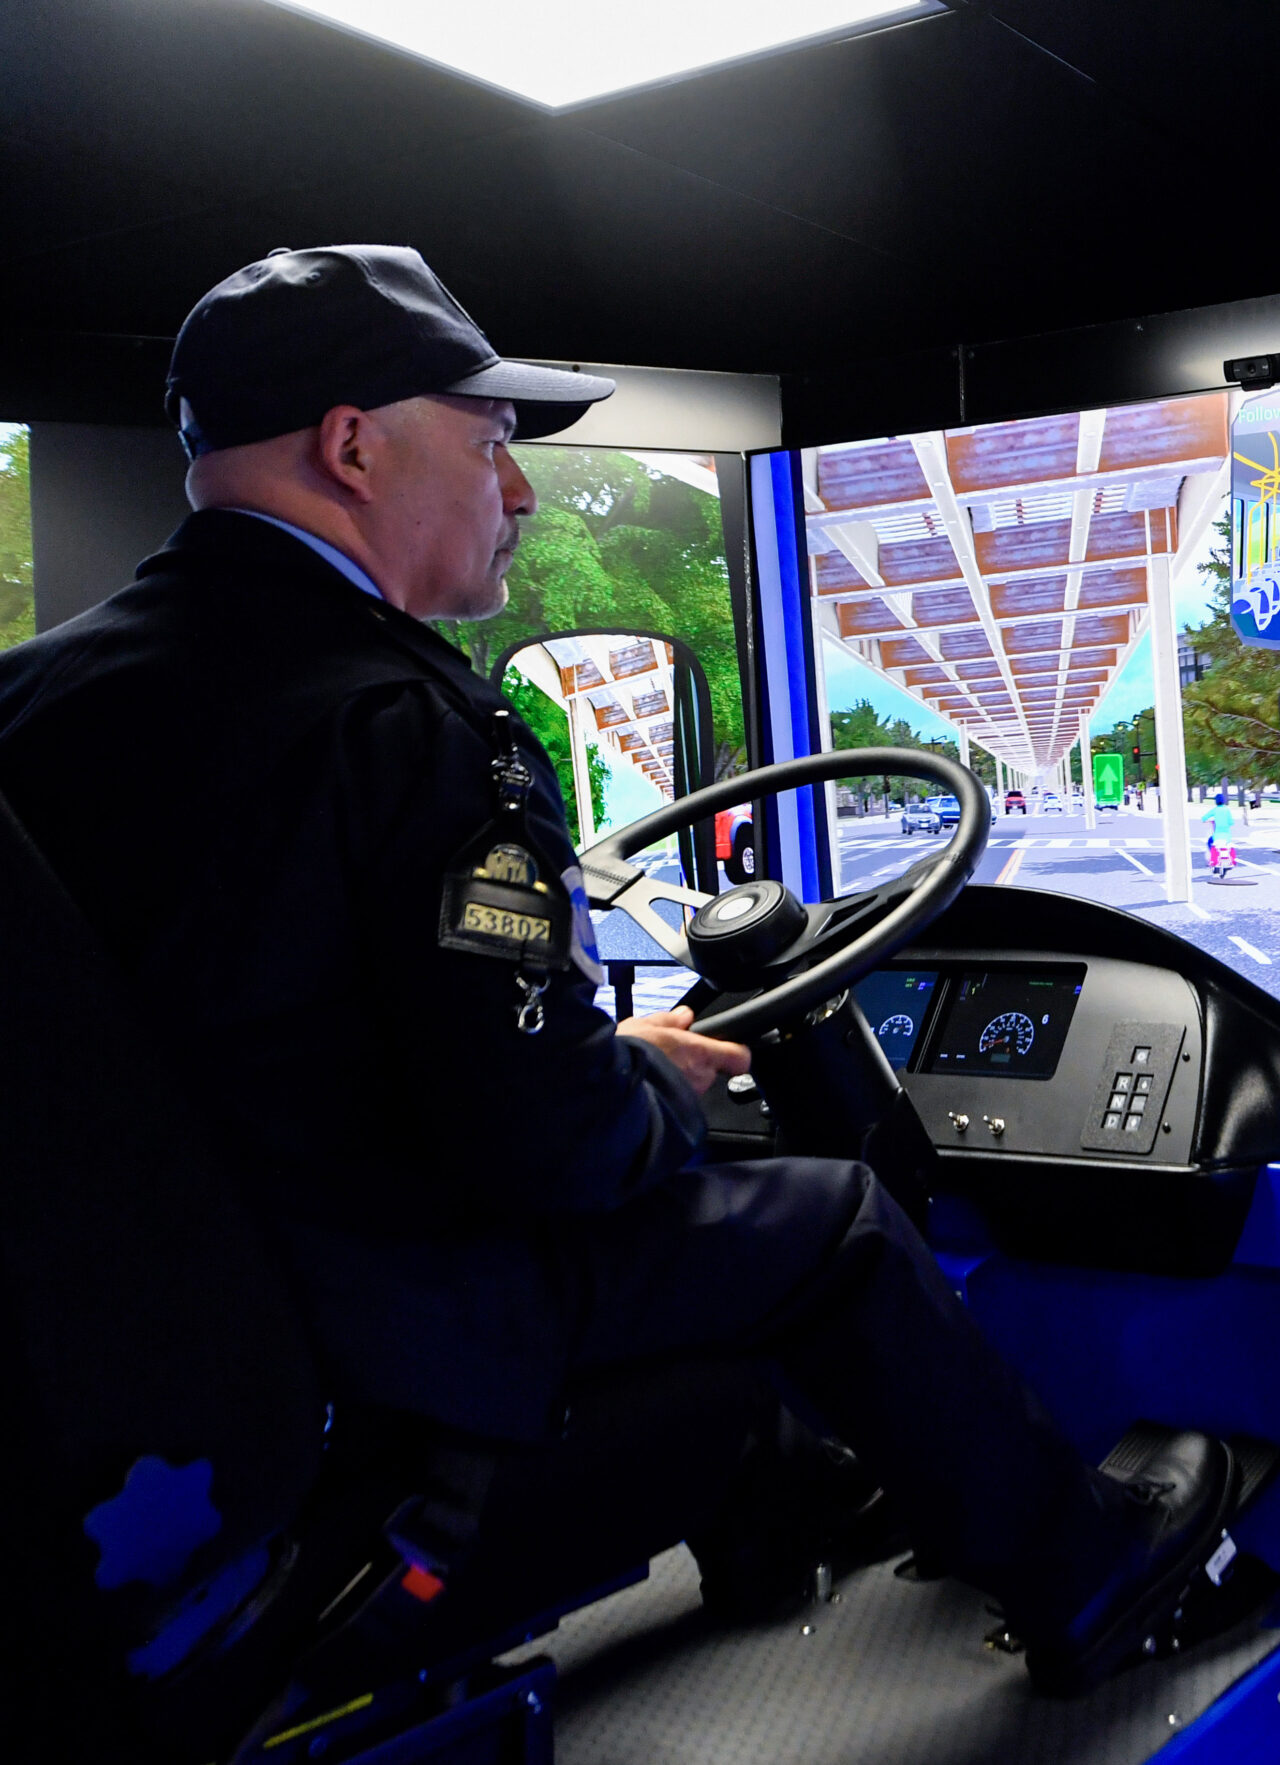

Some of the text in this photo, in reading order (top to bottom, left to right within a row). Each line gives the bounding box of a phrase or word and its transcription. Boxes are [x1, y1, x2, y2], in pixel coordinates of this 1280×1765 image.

[468, 908, 548, 940] 53802
[1119, 1079, 1129, 1090] R
[1112, 1097, 1124, 1108] N
[1106, 1116, 1117, 1127] D
